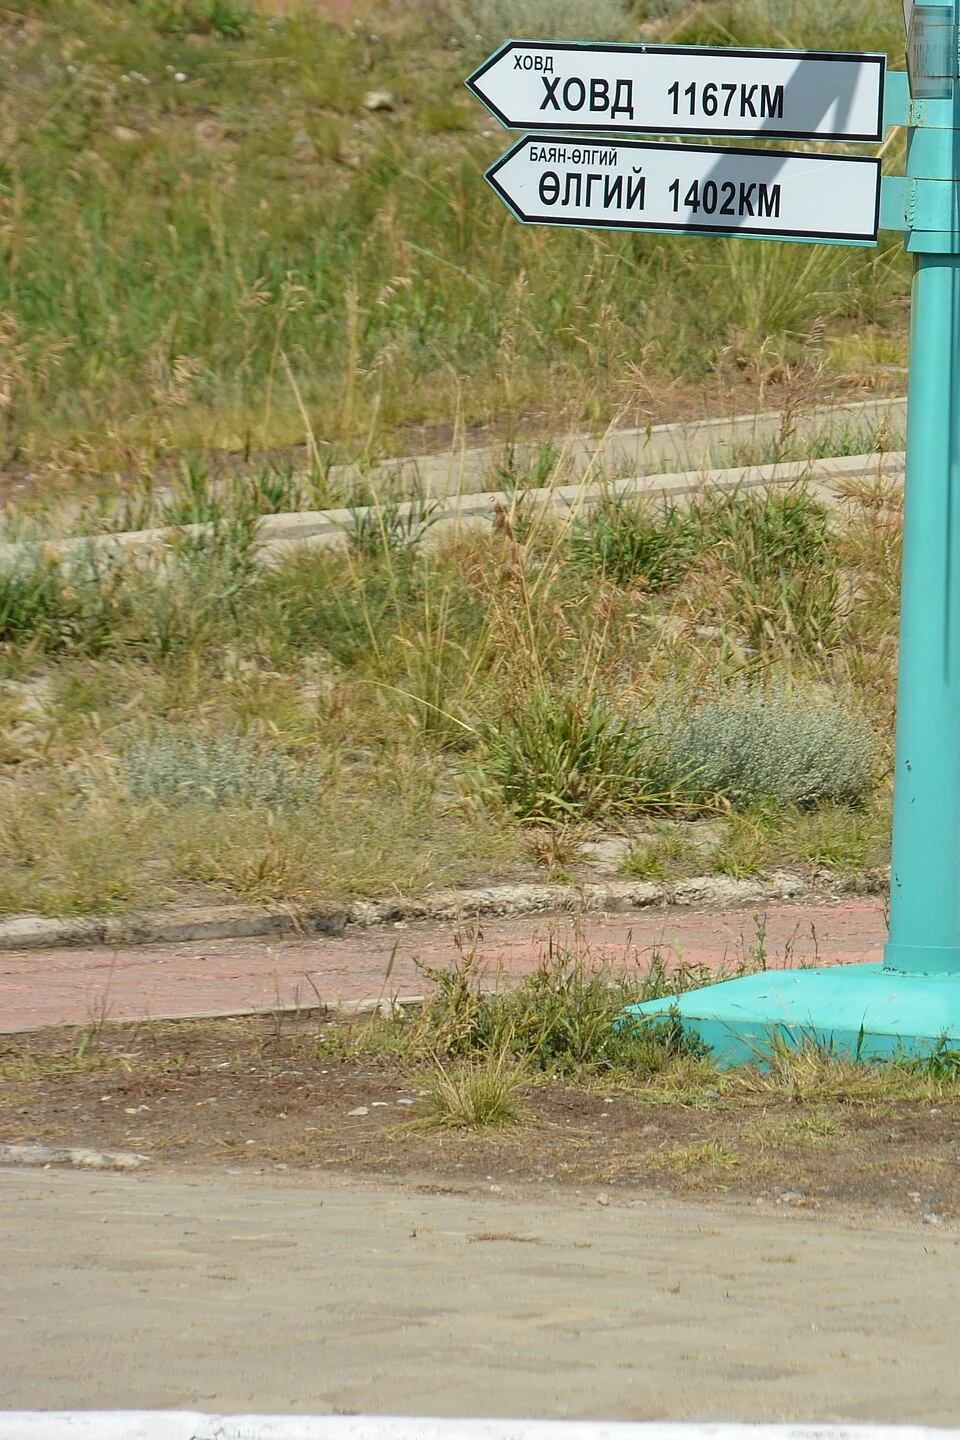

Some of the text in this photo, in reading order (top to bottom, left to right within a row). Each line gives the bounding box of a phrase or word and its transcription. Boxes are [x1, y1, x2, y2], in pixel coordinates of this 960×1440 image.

[513, 54, 554, 74] ХОВД
[540, 77, 784, 120] ХОВД 1167КМ
[529, 146, 618, 167] БАЯН-ӨЛГИЙ
[539, 167, 781, 218] ӨЛГИЙ 1402КМ
